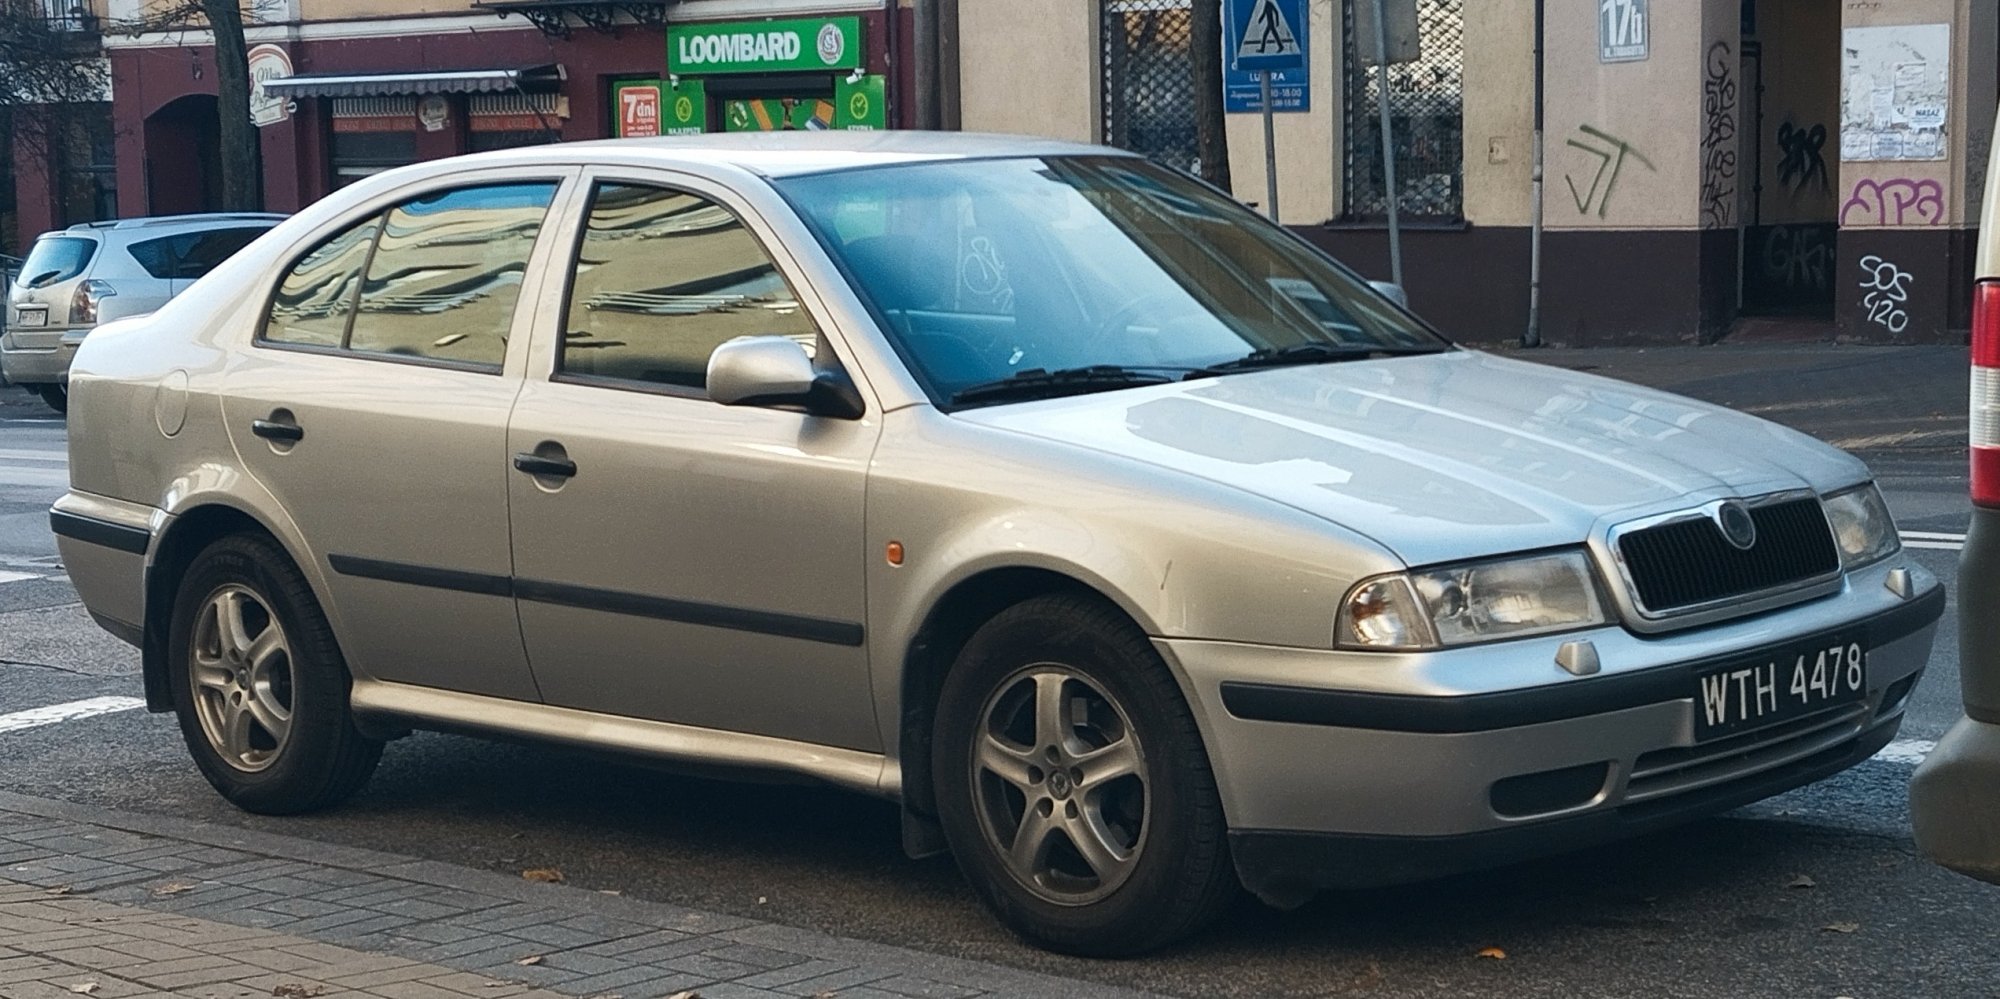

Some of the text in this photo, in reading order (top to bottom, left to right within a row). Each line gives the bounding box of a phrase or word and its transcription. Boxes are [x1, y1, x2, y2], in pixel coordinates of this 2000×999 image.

[679, 31, 801, 64] LOOMBARD
[623, 93, 656, 124] 7 dni
[1860, 255, 1913, 301] SOS
[1701, 643, 1861, 726] WTH 4478
